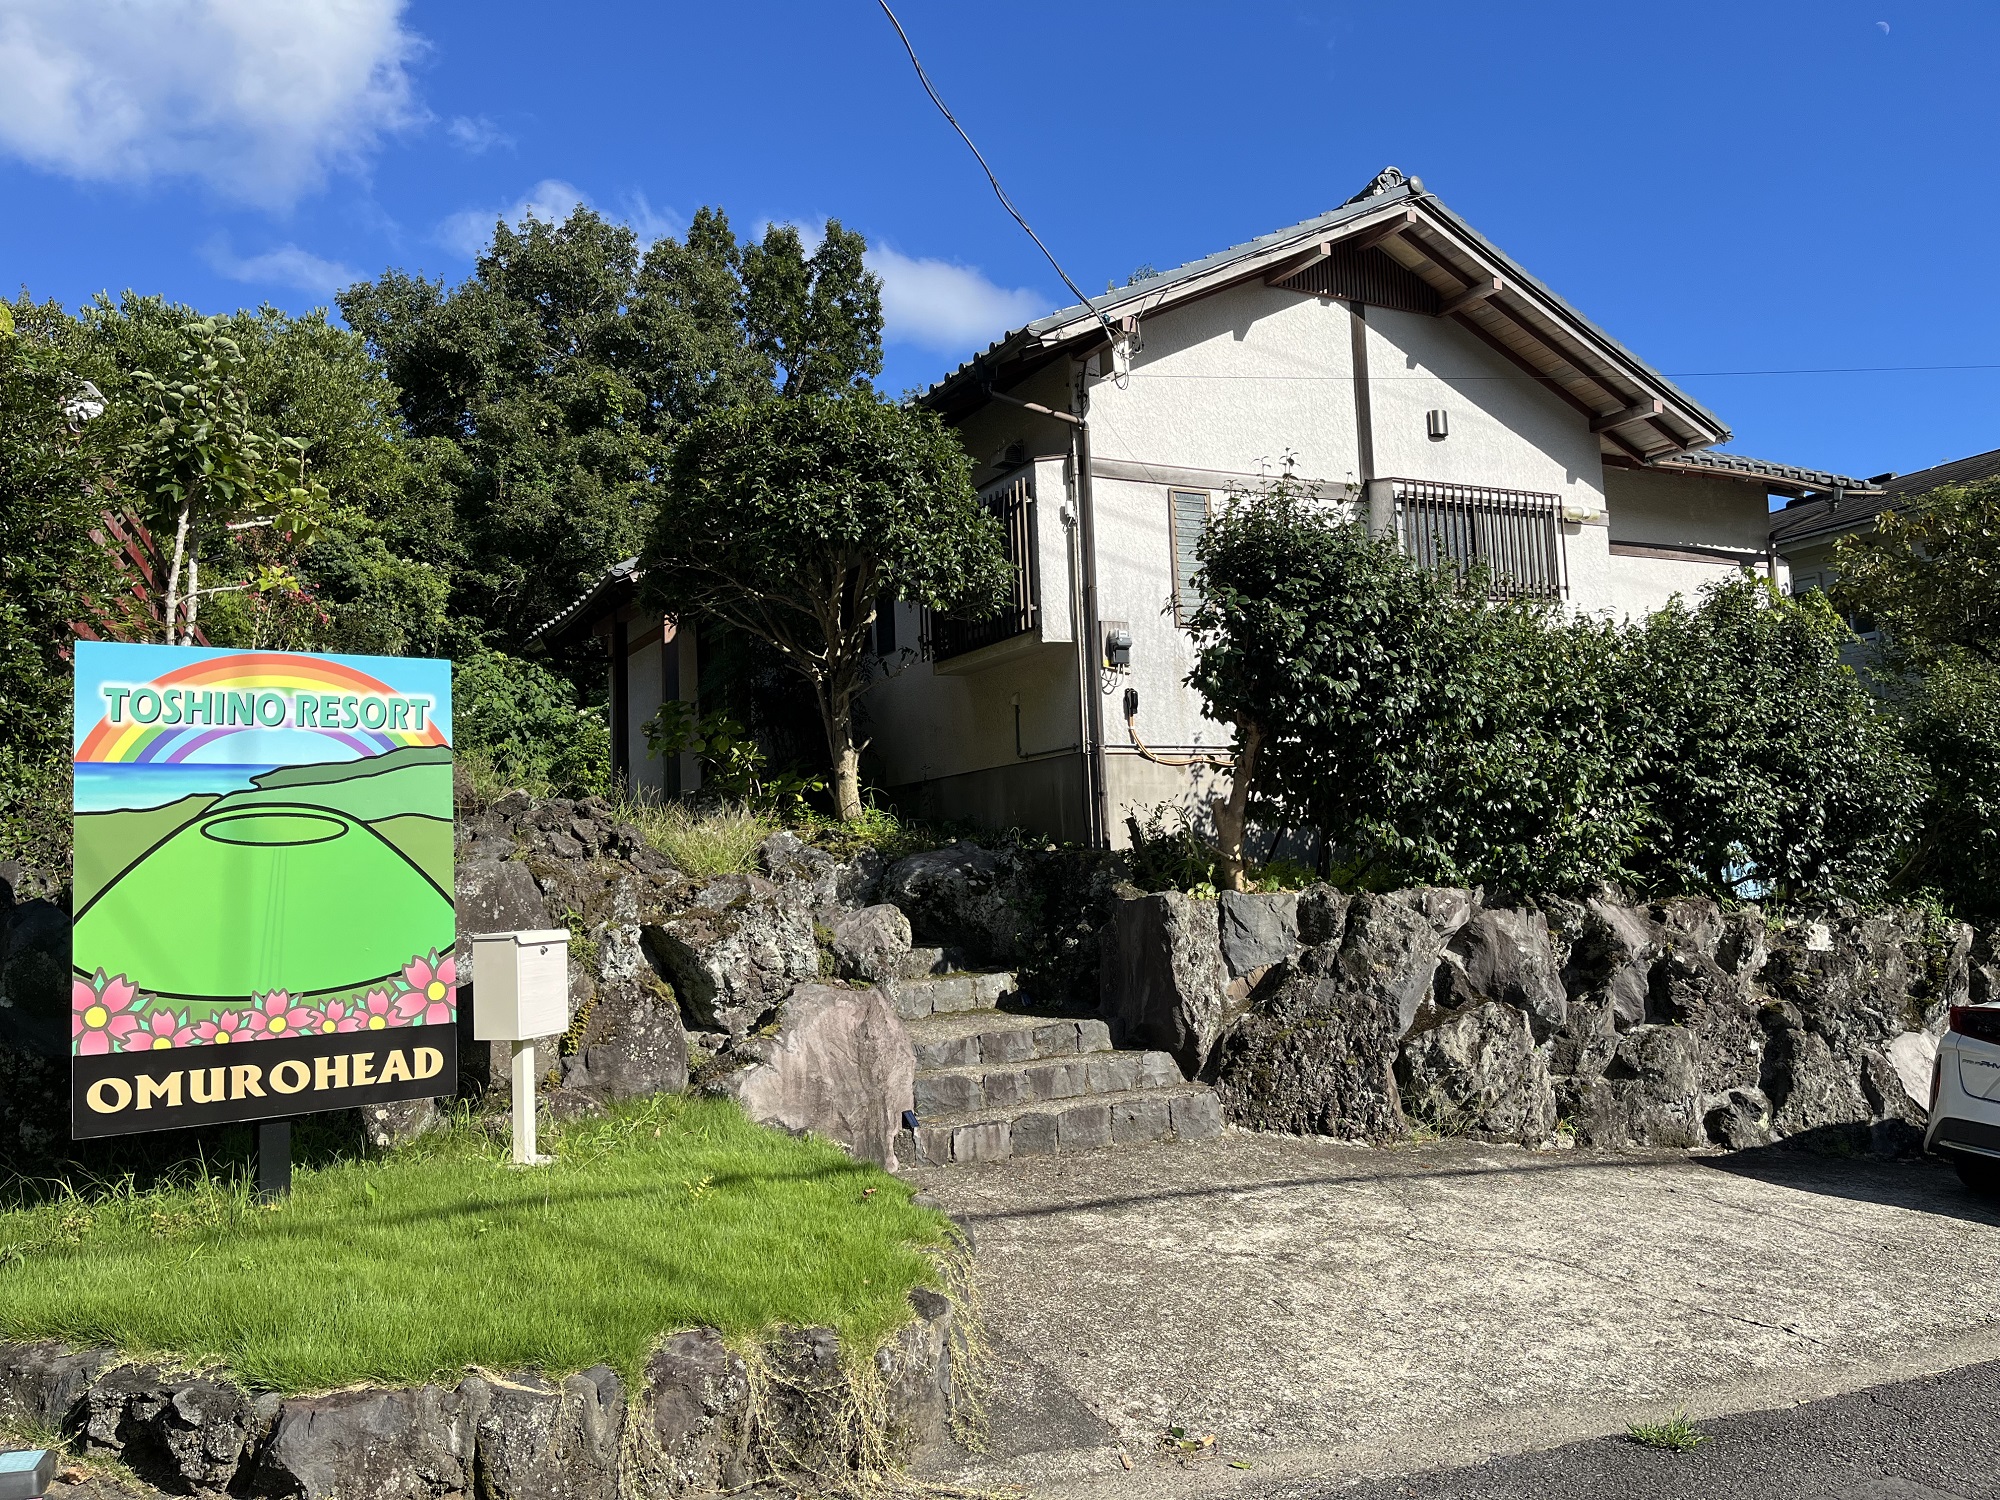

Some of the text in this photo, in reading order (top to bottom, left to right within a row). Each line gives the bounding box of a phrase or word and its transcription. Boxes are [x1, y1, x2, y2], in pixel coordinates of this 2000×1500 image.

[103, 687, 430, 730] TOSHINO RESORT
[86, 1046, 444, 1114] OMUROHEAD
